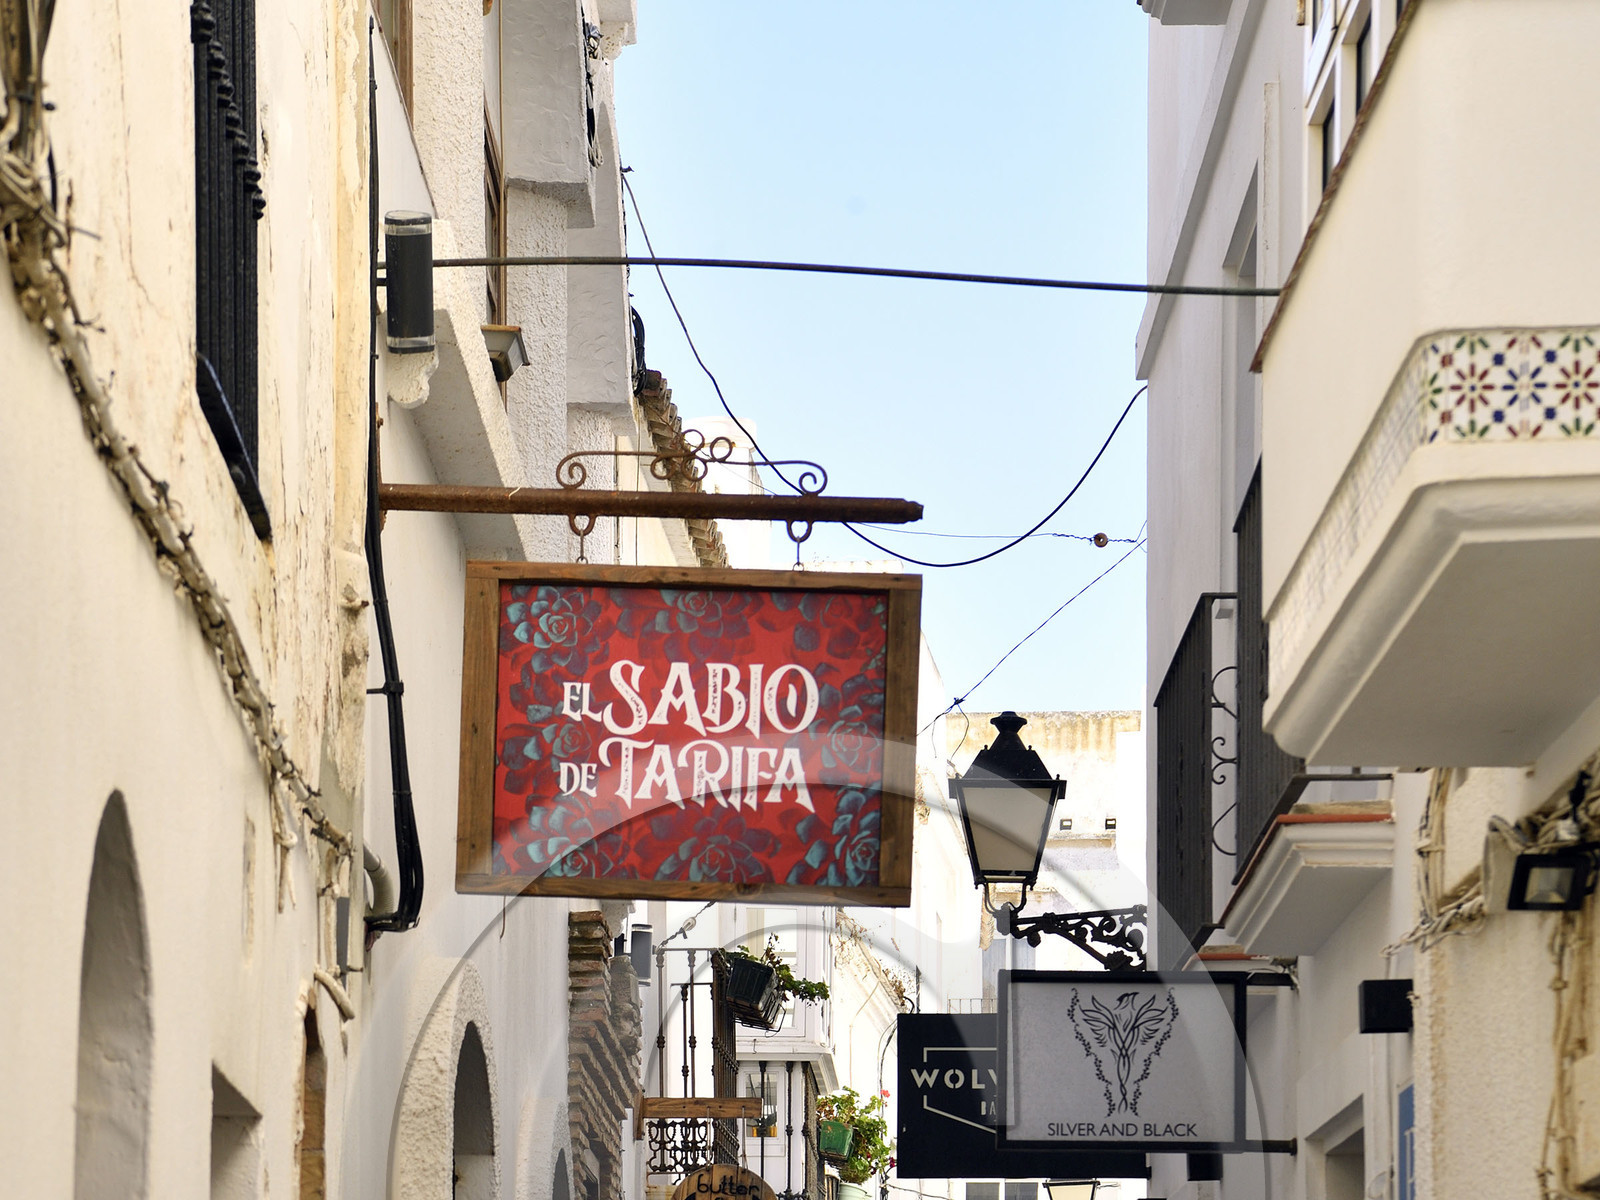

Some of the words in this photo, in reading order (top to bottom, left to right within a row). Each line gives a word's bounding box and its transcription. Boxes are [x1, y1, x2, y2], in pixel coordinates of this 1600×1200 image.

[561, 682, 602, 723] EL
[602, 659, 819, 739] SABIO
[559, 762, 597, 798] DE
[598, 737, 815, 813] TARIFA
[1047, 1122, 1096, 1137] SILVER
[1099, 1123, 1138, 1137] AND
[1143, 1123, 1198, 1137] BLACK
[697, 1173, 760, 1195] butter
